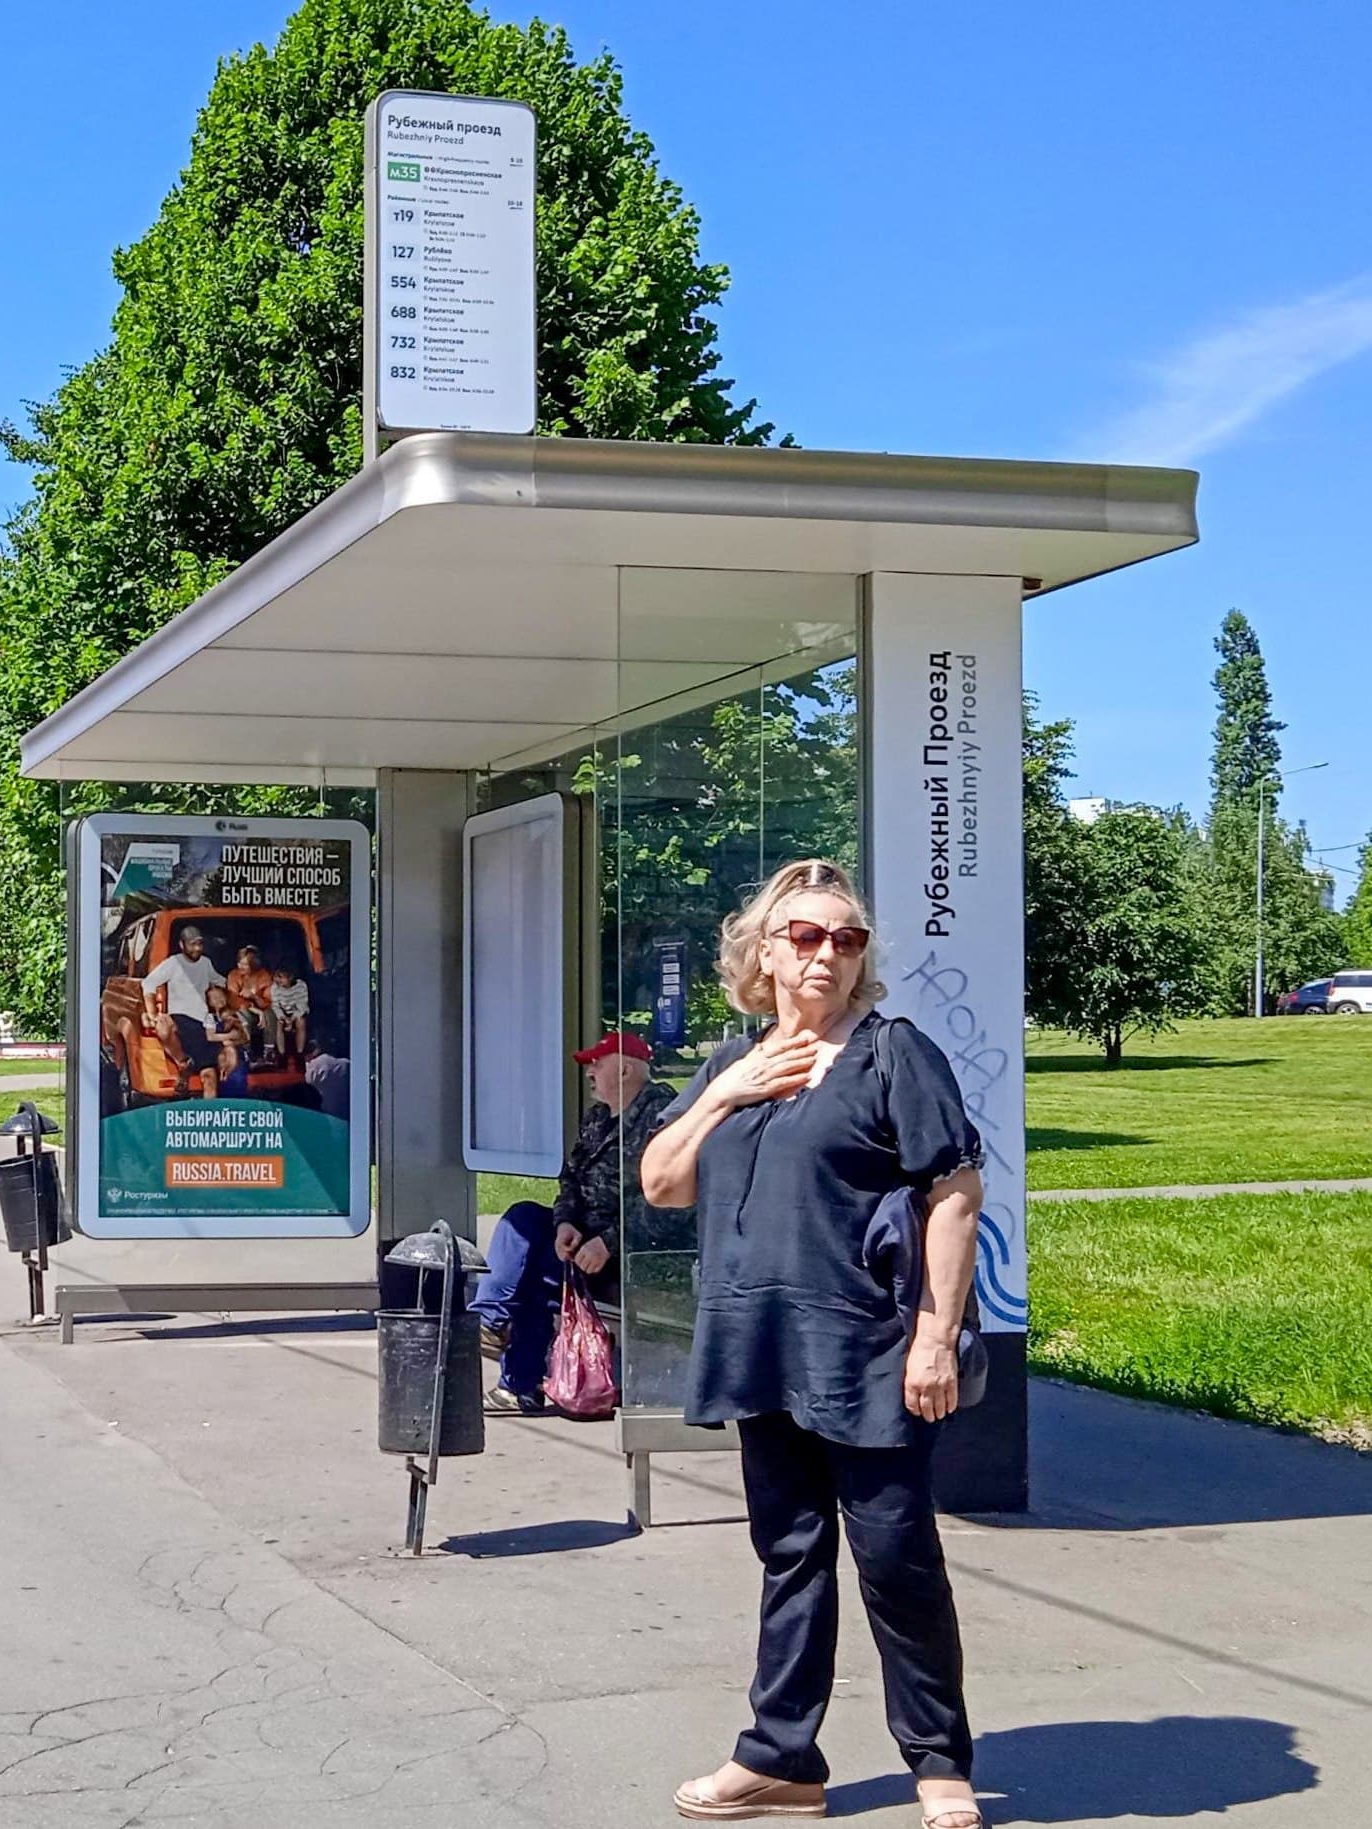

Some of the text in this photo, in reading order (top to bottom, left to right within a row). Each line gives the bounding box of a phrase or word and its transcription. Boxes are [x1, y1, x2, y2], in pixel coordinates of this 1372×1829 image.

[387, 115, 502, 136] Рубежный проезд
[387, 130, 464, 145] Rubezhniy Proezd
[392, 246, 414, 259] 127
[391, 276, 416, 289] 554
[391, 306, 416, 319] 688
[391, 336, 416, 349] 732
[391, 366, 416, 379] 832
[956, 654, 981, 877] Rubezhnyiy Proezd
[923, 651, 956, 936] Рубежный Проезд
[222, 845, 324, 865] ПУТЕШЕСТВИЯ
[222, 864, 341, 886] ЛУЧШИЙ СПОСОБ
[222, 887, 319, 906] БЫТЬ ВМЕСТЕ
[165, 1108, 283, 1128] ВЫБИРАЙТЕ СВОЙ
[165, 1131, 283, 1149] АВТОМАРШРУТ НА
[172, 1162, 276, 1182] RUSSIA.TRAVEL
